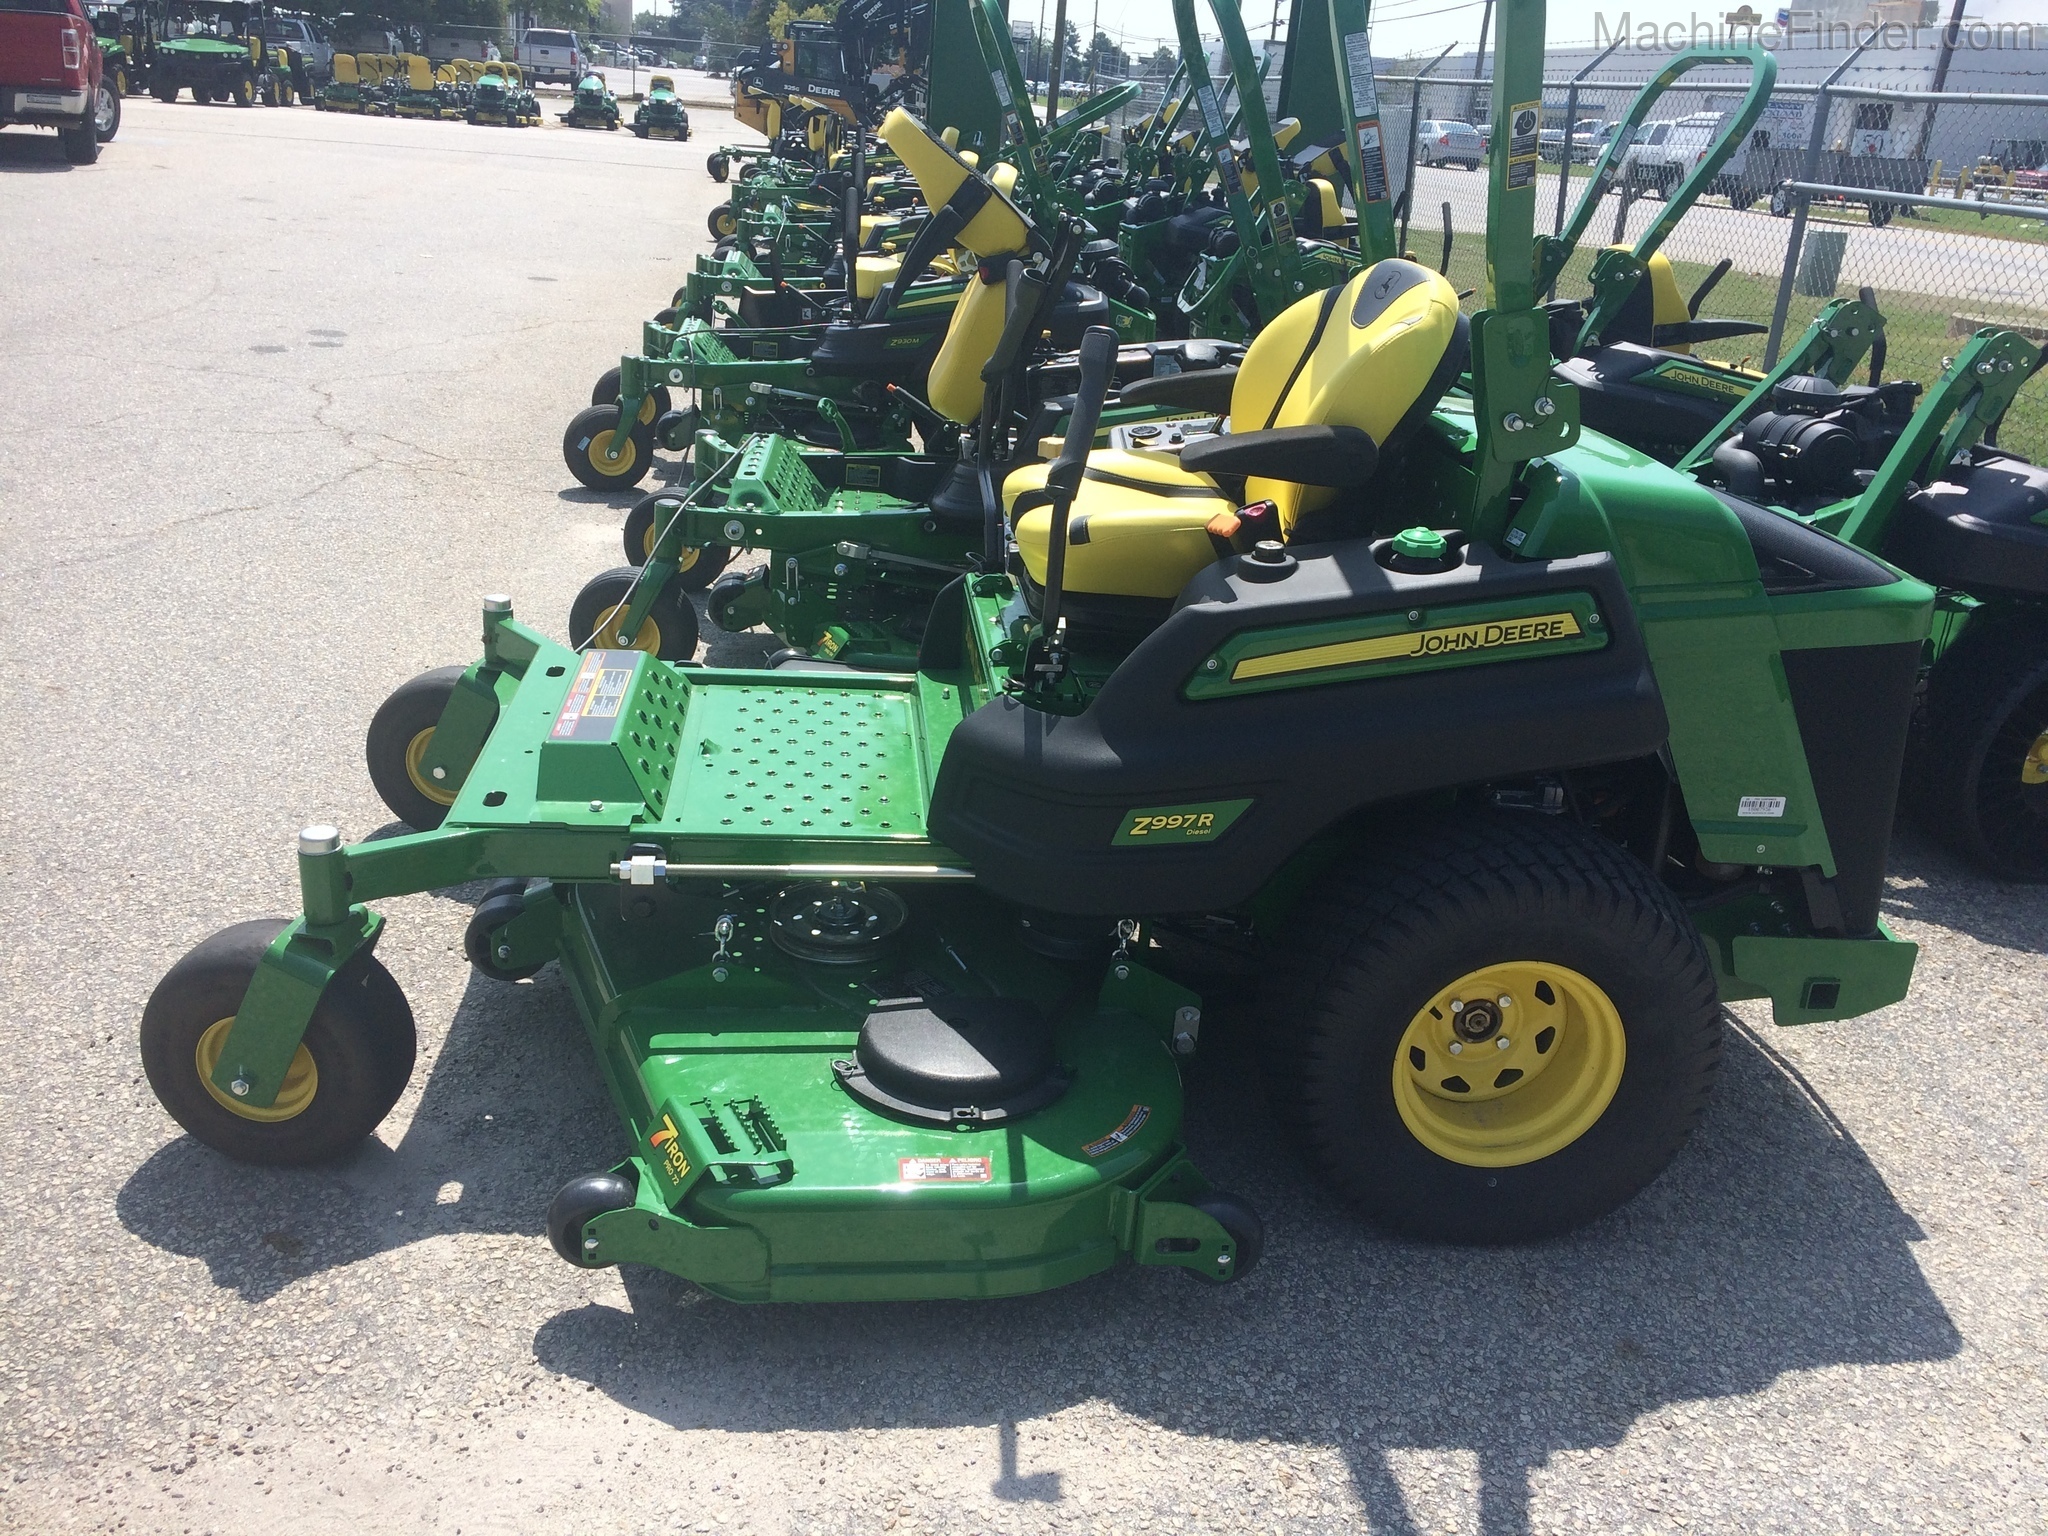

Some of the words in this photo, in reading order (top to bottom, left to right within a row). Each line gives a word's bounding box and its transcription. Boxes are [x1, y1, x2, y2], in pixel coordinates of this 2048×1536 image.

[862, 1, 883, 20] DEERE
[808, 84, 840, 97] DEERE
[1670, 370, 1700, 385] JOHN
[1701, 378, 1735, 394] DEERE
[1410, 631, 1478, 655] JOHN
[1484, 620, 1564, 645] DEERE
[1129, 813, 1215, 835] Z997R
[1186, 828, 1212, 836] Diesel
[663, 1159, 674, 1176] PRO
[671, 1174, 680, 1186] 72
